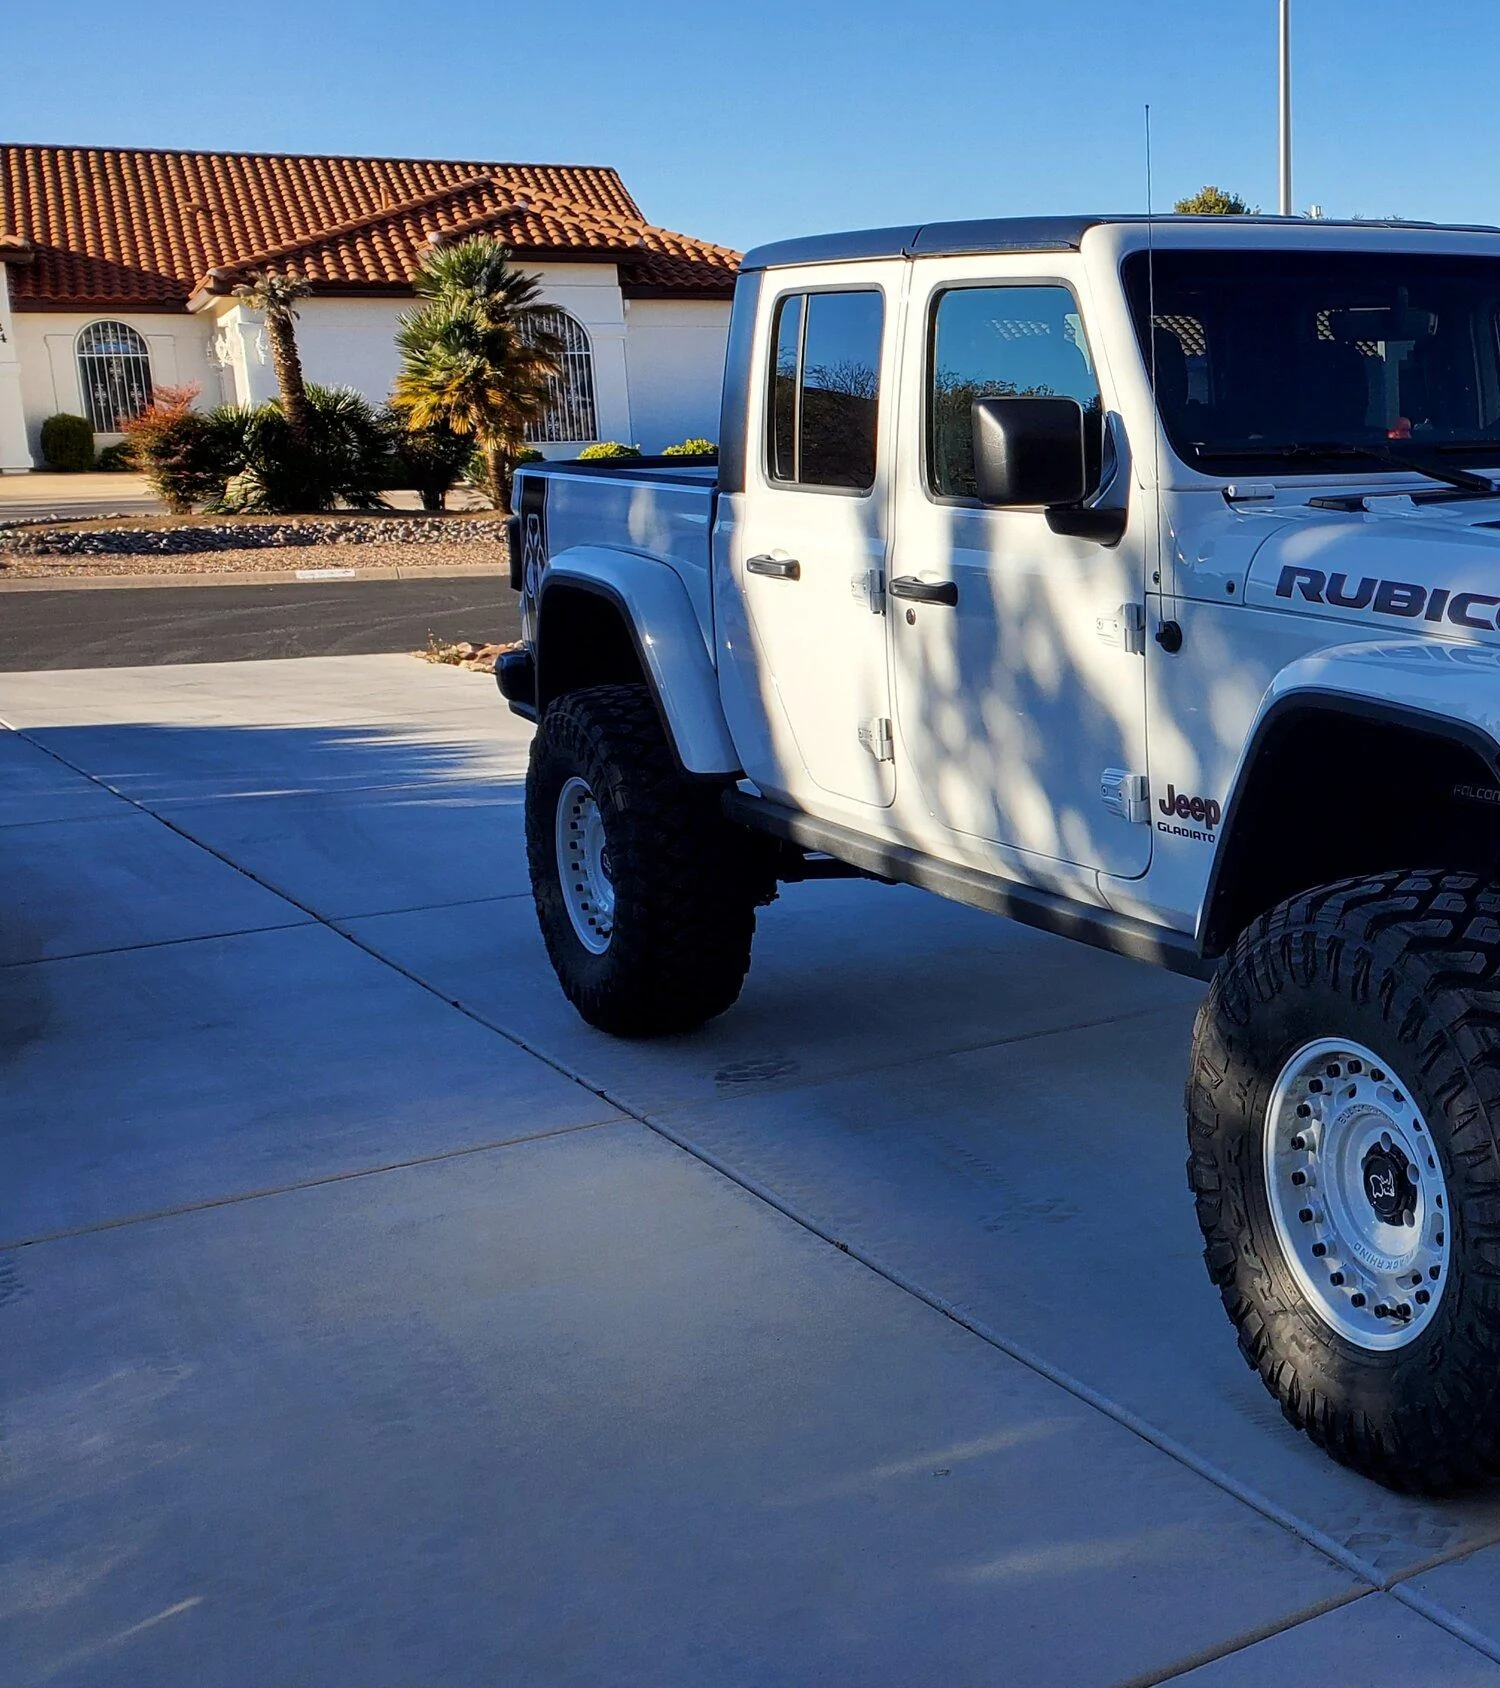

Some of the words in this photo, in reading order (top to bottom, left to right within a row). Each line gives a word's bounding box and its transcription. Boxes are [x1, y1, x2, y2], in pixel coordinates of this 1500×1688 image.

[1158, 783, 1221, 831] Jeep
[1157, 821, 1216, 843] GLADIATO
[1354, 1242, 1385, 1270] RHINO
